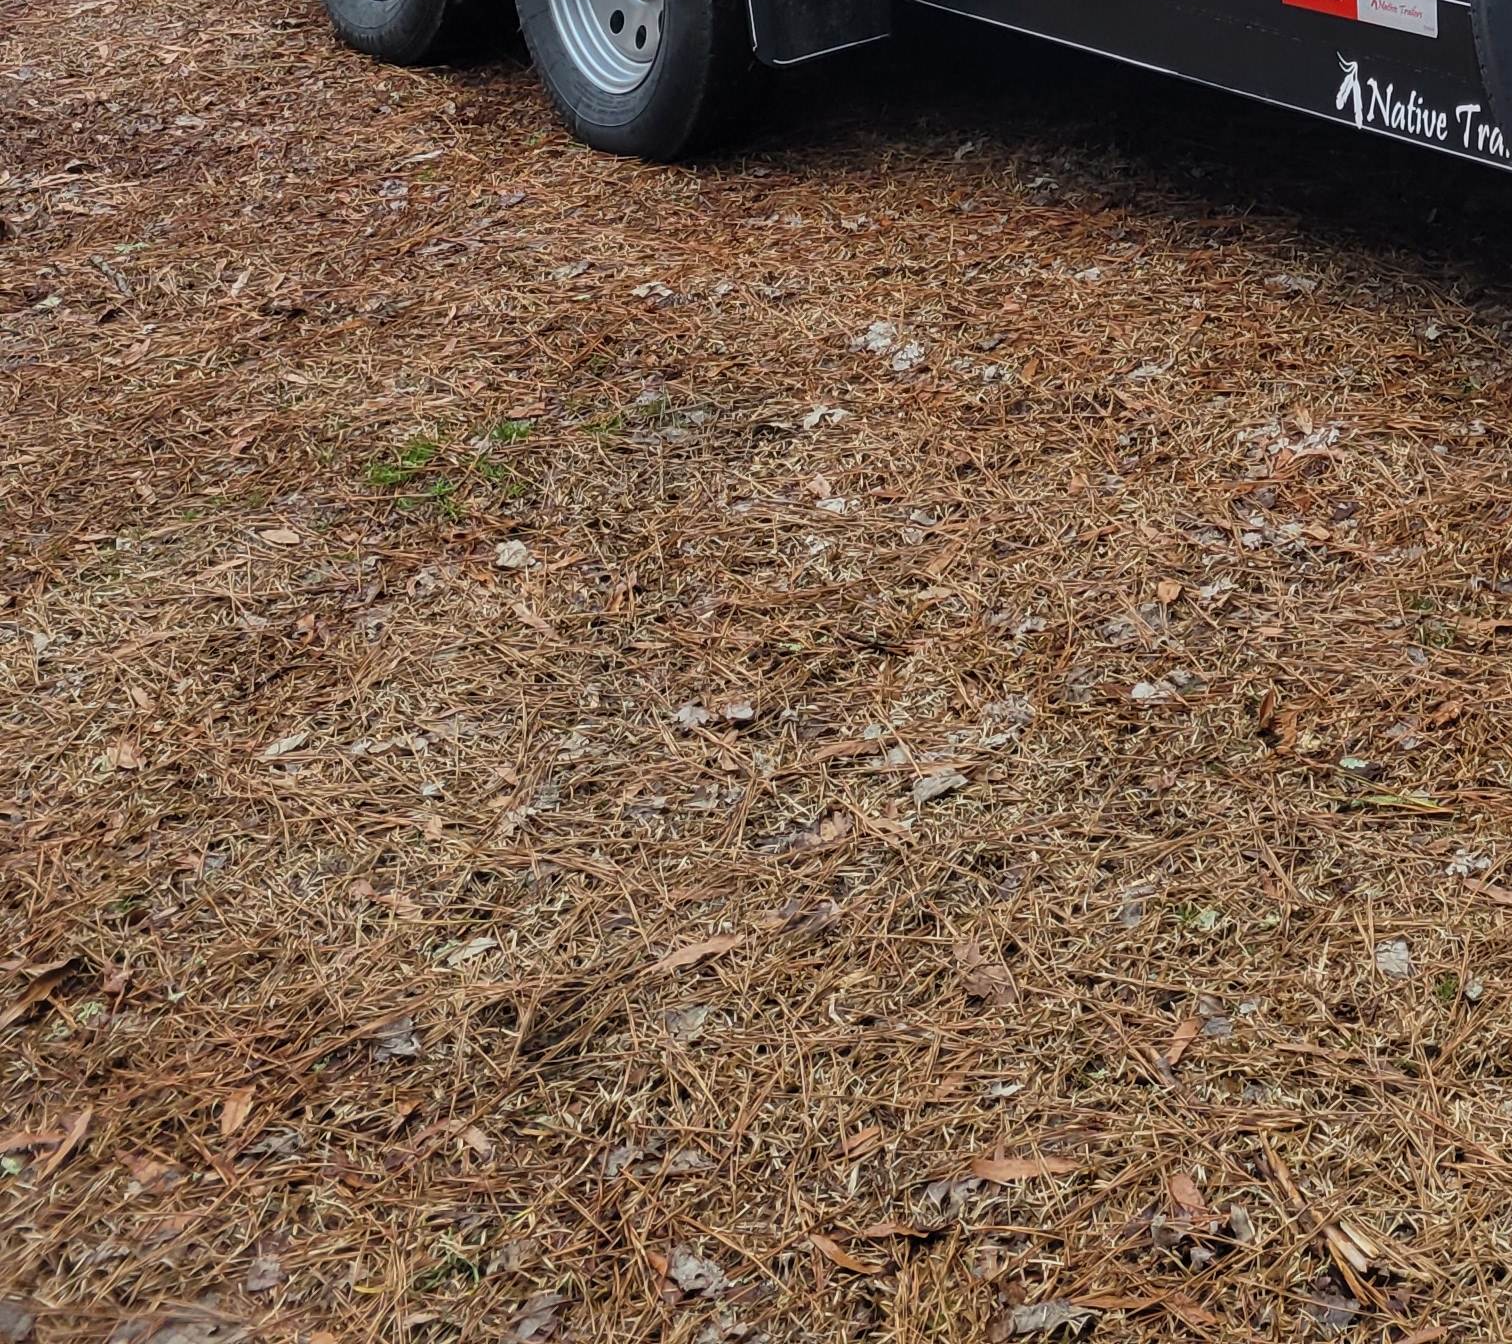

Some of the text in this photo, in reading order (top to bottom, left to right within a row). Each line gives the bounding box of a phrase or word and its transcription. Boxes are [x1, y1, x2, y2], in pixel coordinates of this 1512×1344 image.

[1378, 0, 1423, 19] Native Trailers
[1366, 77, 1448, 141] Native
